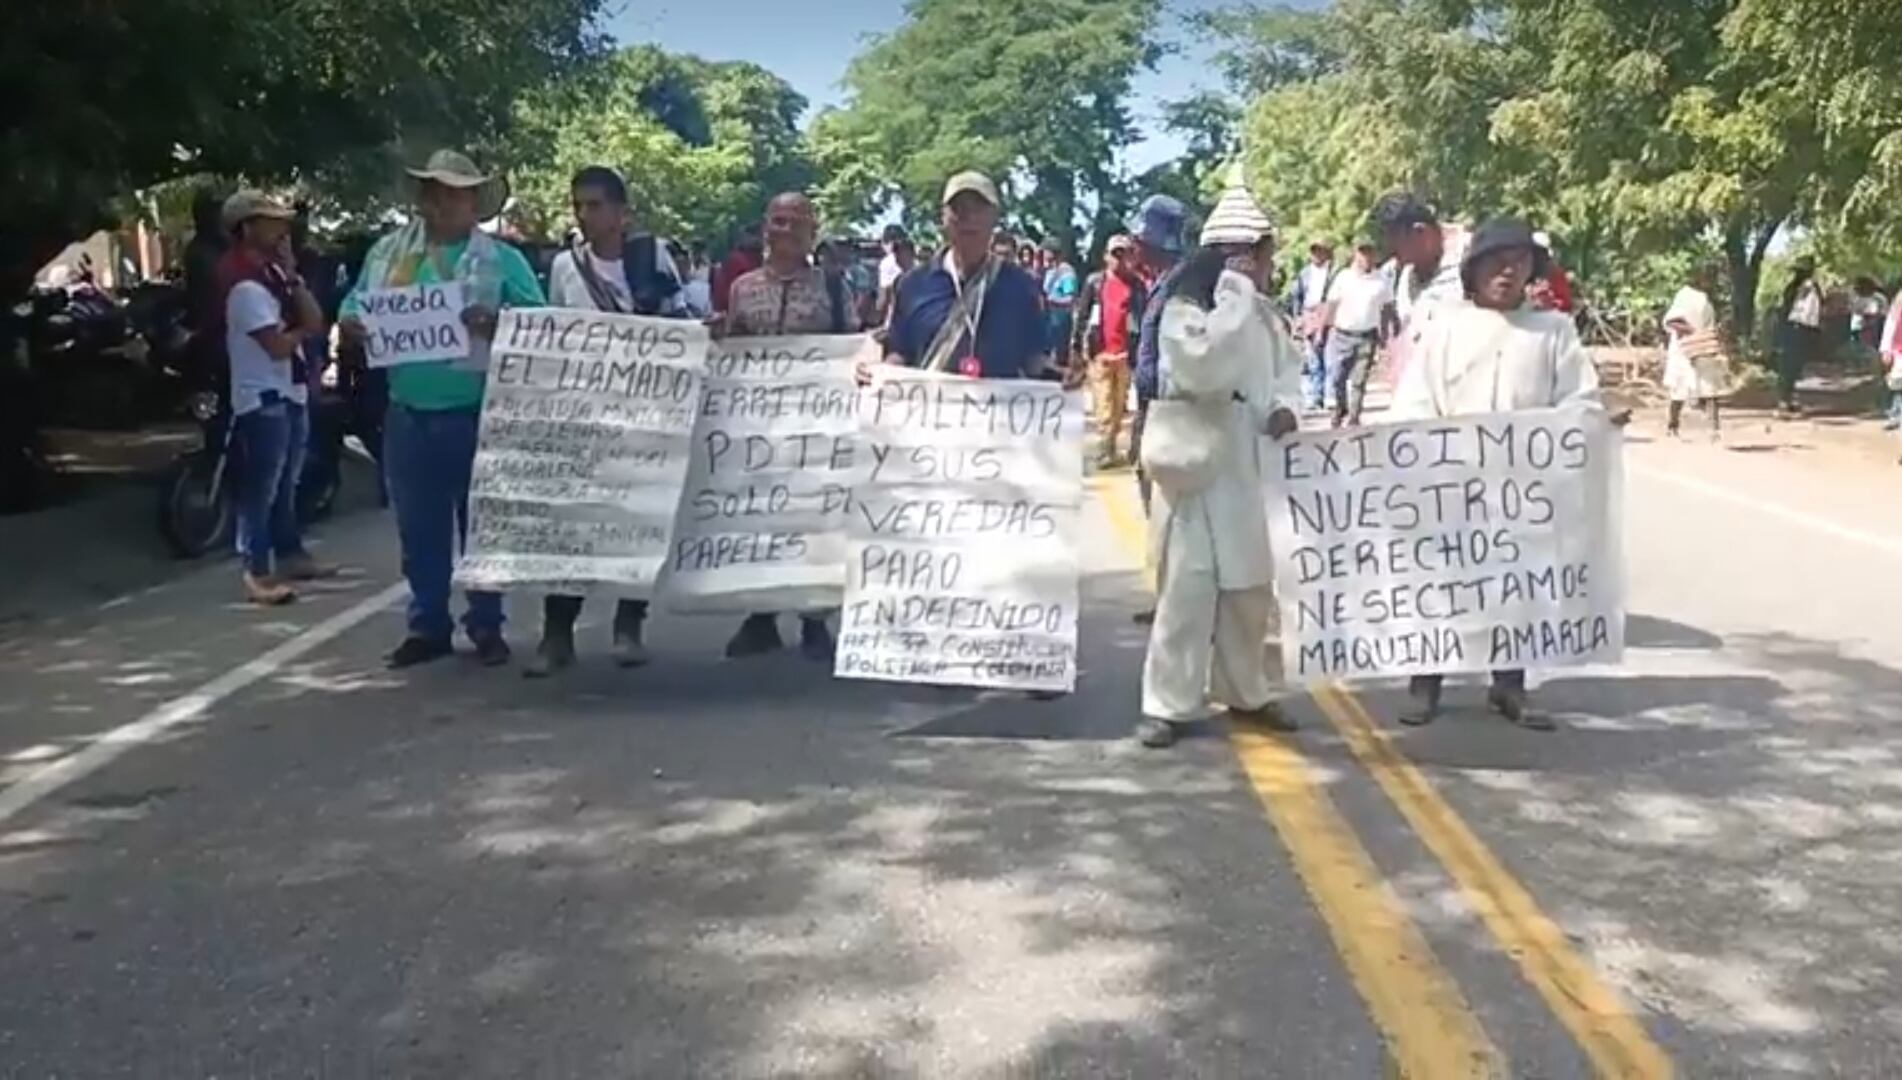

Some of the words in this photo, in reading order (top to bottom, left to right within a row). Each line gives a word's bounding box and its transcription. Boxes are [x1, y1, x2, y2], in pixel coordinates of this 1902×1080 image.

[510, 313, 688, 358] HACEMOS
[498, 354, 535, 385] EL
[557, 358, 692, 401] LLAMADO
[873, 380, 1066, 440] PALMOR
[910, 445, 1003, 481] SUS
[1284, 424, 1589, 480] EXIGIMOS
[692, 485, 790, 520] SOLO
[859, 499, 1057, 538] VEREDAS
[1287, 477, 1554, 535] NUESTROS
[675, 533, 808, 572] PAPELES
[860, 545, 961, 590] PARO
[1291, 529, 1520, 585] DERECHOS
[849, 595, 1063, 633] INDEFINIDO
[1300, 628, 1464, 675] MAQUINA
